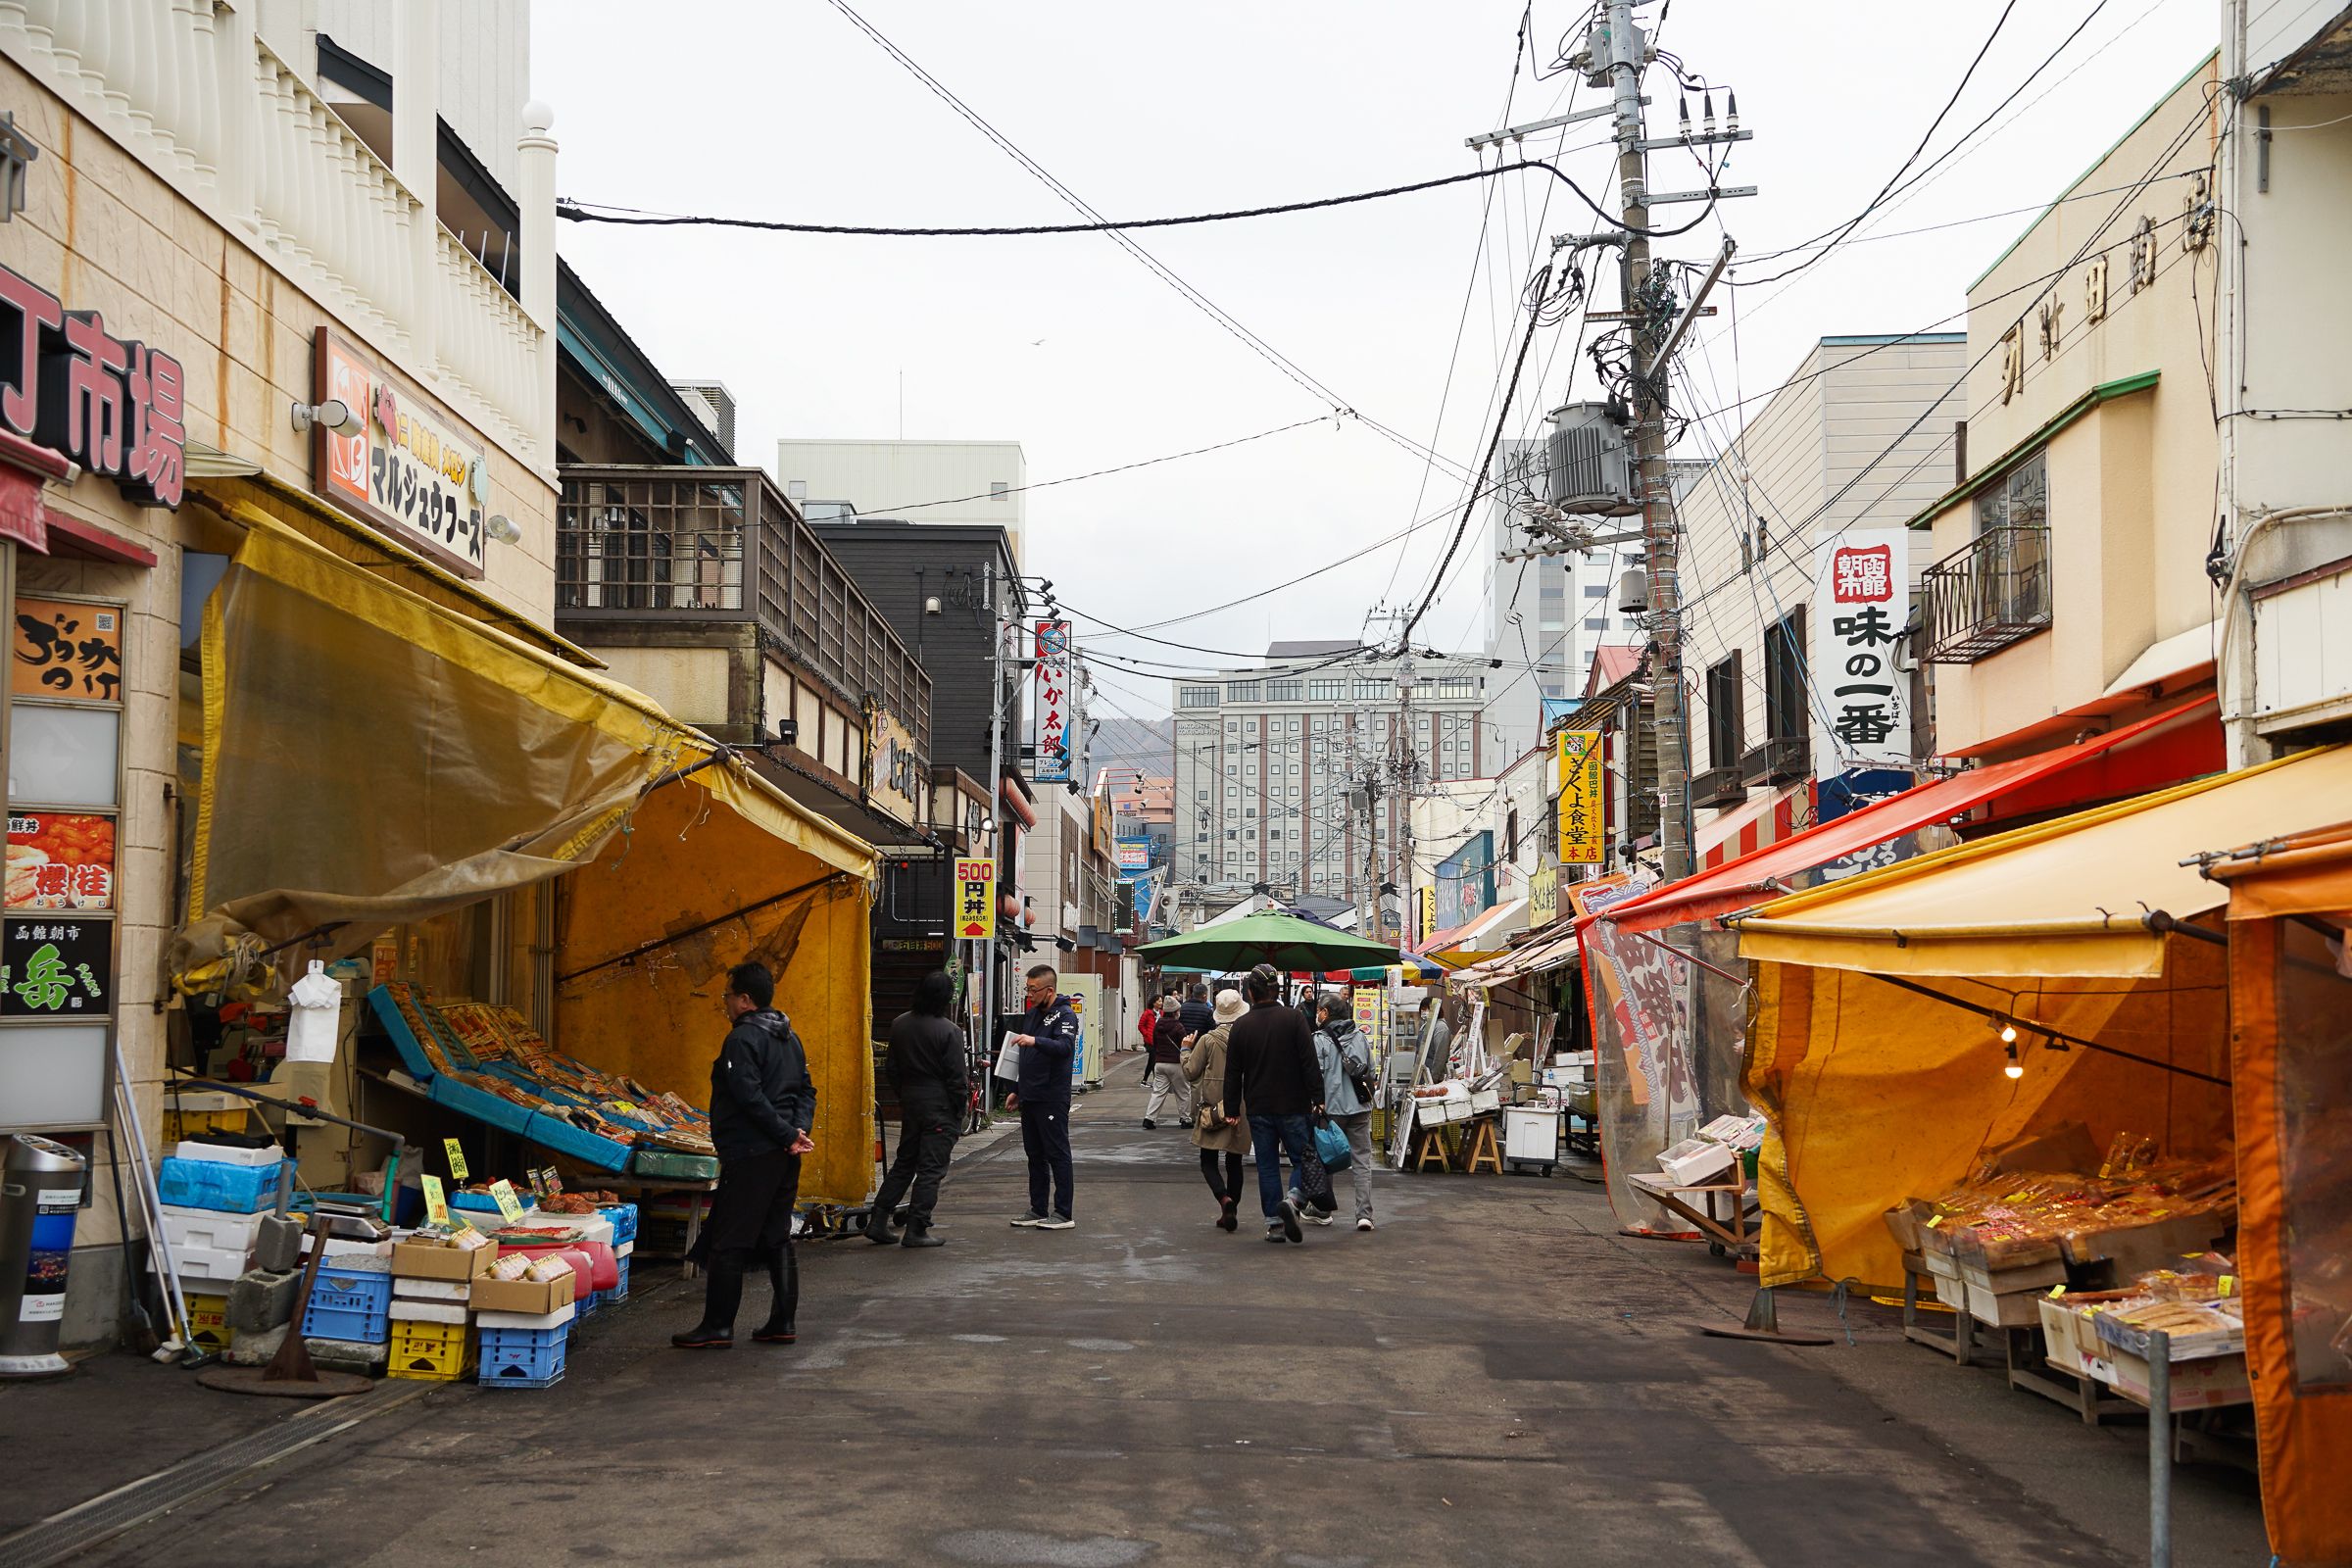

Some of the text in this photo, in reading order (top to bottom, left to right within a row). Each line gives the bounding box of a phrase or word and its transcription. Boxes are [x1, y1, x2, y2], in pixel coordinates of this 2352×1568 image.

[371, 446, 481, 563] マルジュウフーズ
[1834, 606, 1894, 745] 味の一番
[1042, 668, 1064, 756] いか太郎
[1566, 758, 1590, 846] きくよ食堂
[7, 818, 38, 832] 鮮丼
[1567, 846, 1598, 861] 本店
[957, 862, 992, 882] 500
[963, 881, 986, 915] 円丼
[16, 924, 81, 941] 函館朝市
